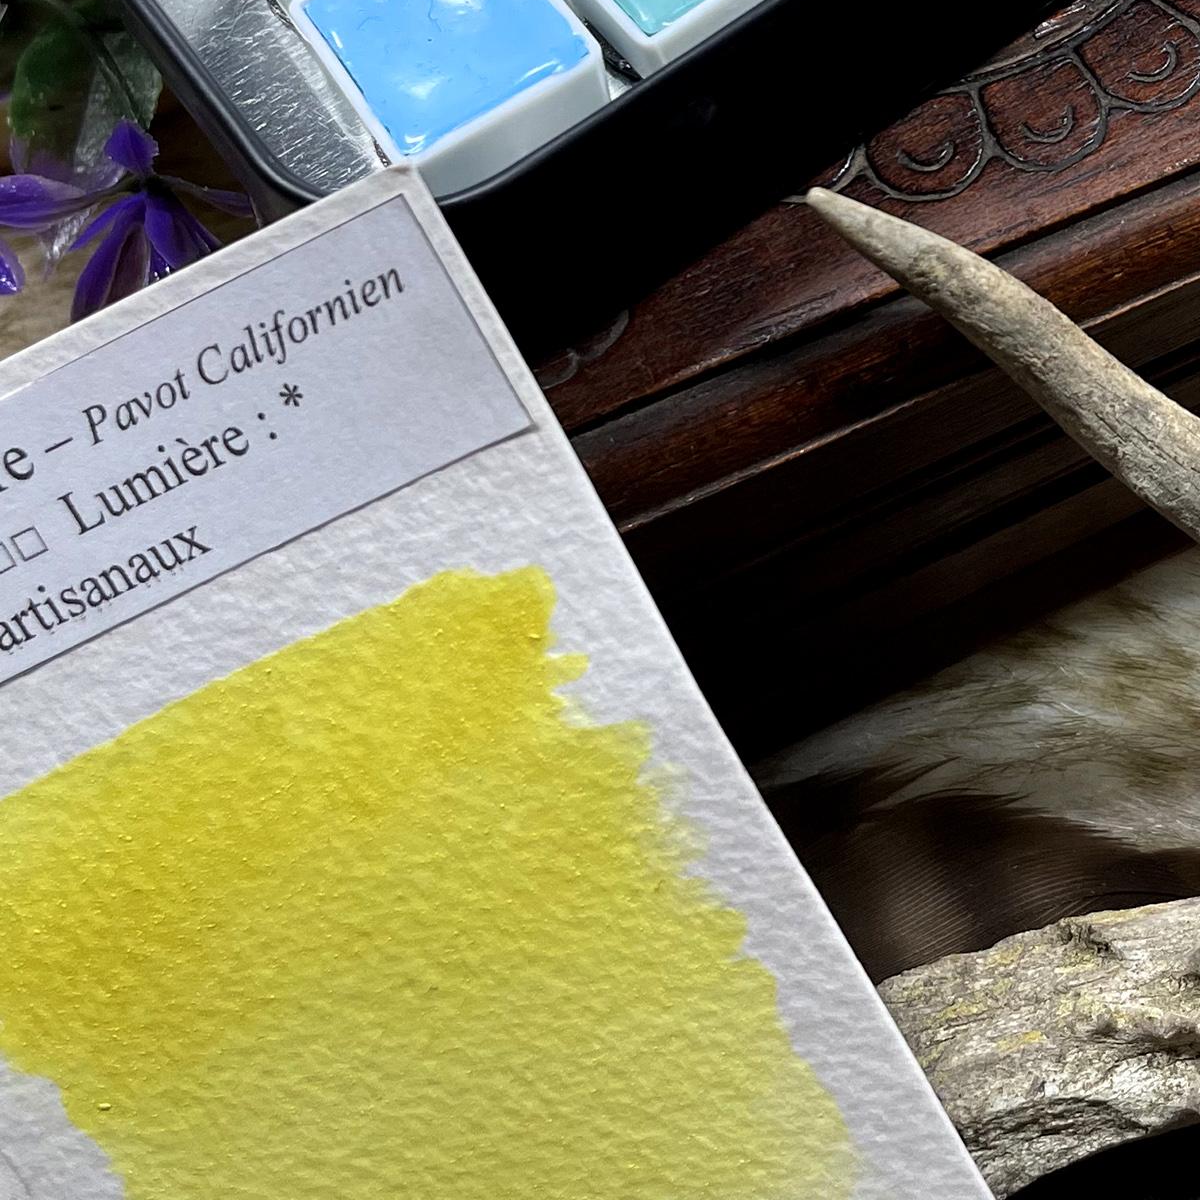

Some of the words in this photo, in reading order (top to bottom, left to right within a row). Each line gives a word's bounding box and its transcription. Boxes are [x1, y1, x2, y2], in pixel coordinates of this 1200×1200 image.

[0, 446, 35, 493] e
[82, 368, 191, 446] Pavot
[196, 266, 405, 386] Californien
[57, 425, 250, 536] Lumière
[0, 525, 213, 652] artisanaux
